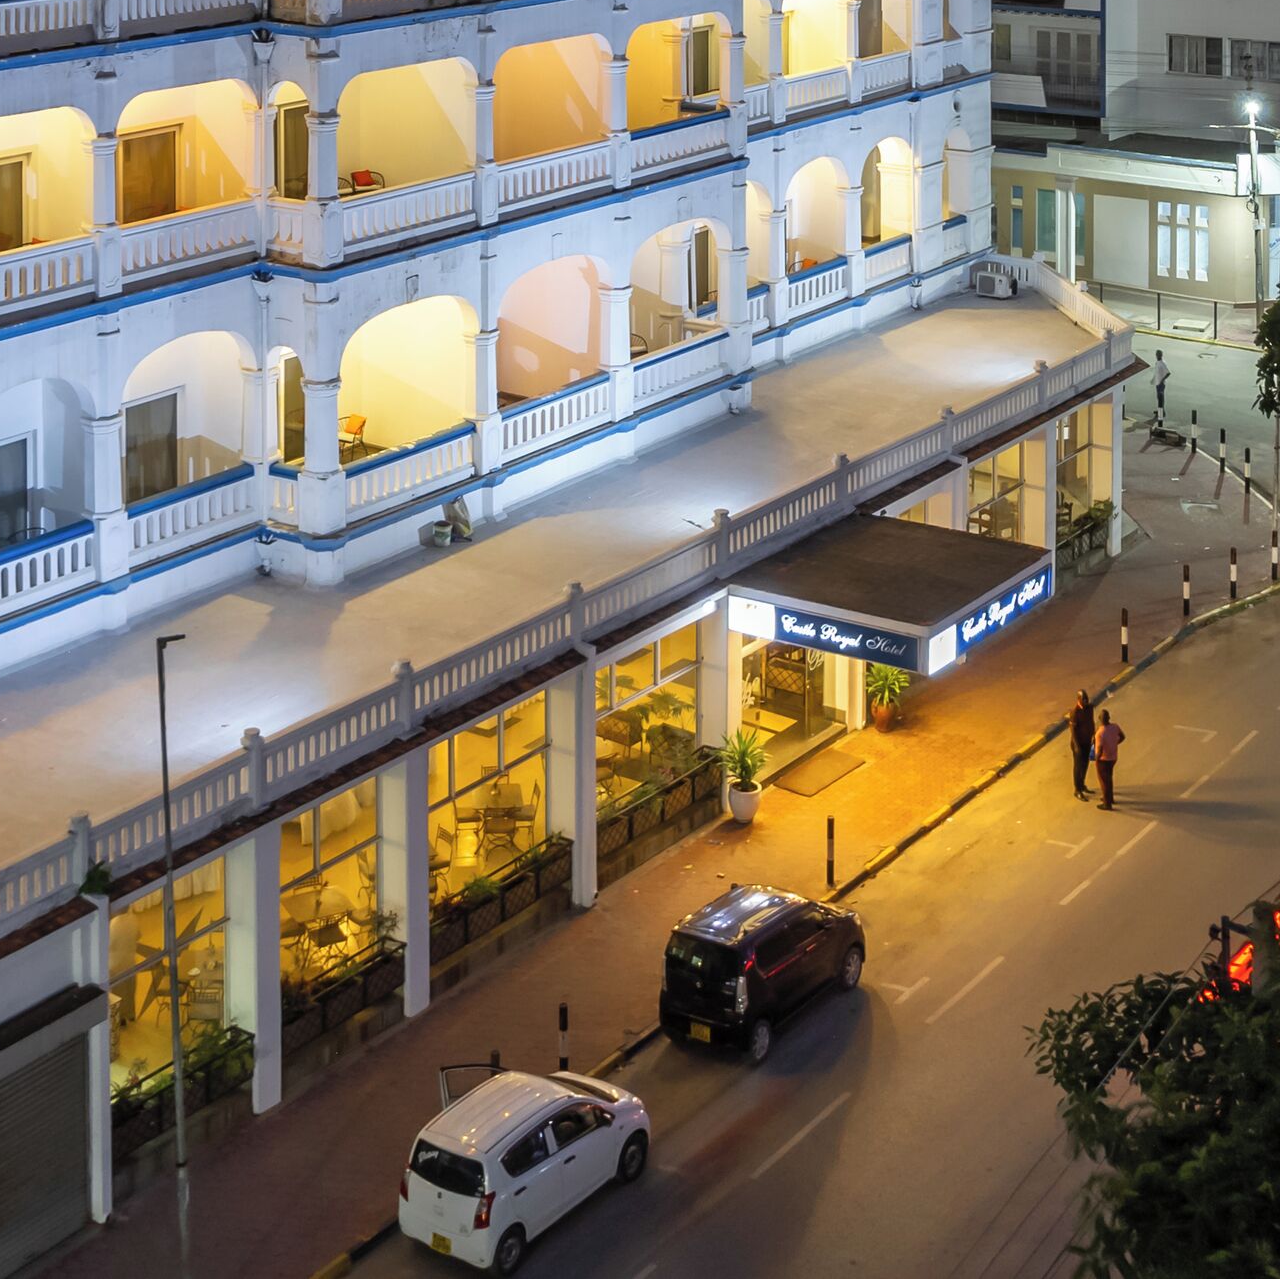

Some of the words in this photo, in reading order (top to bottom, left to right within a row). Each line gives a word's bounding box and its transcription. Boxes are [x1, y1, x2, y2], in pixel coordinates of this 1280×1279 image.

[781, 614, 816, 637] Castle
[821, 624, 863, 650] Royal
[866, 636, 907, 656] Hotel
